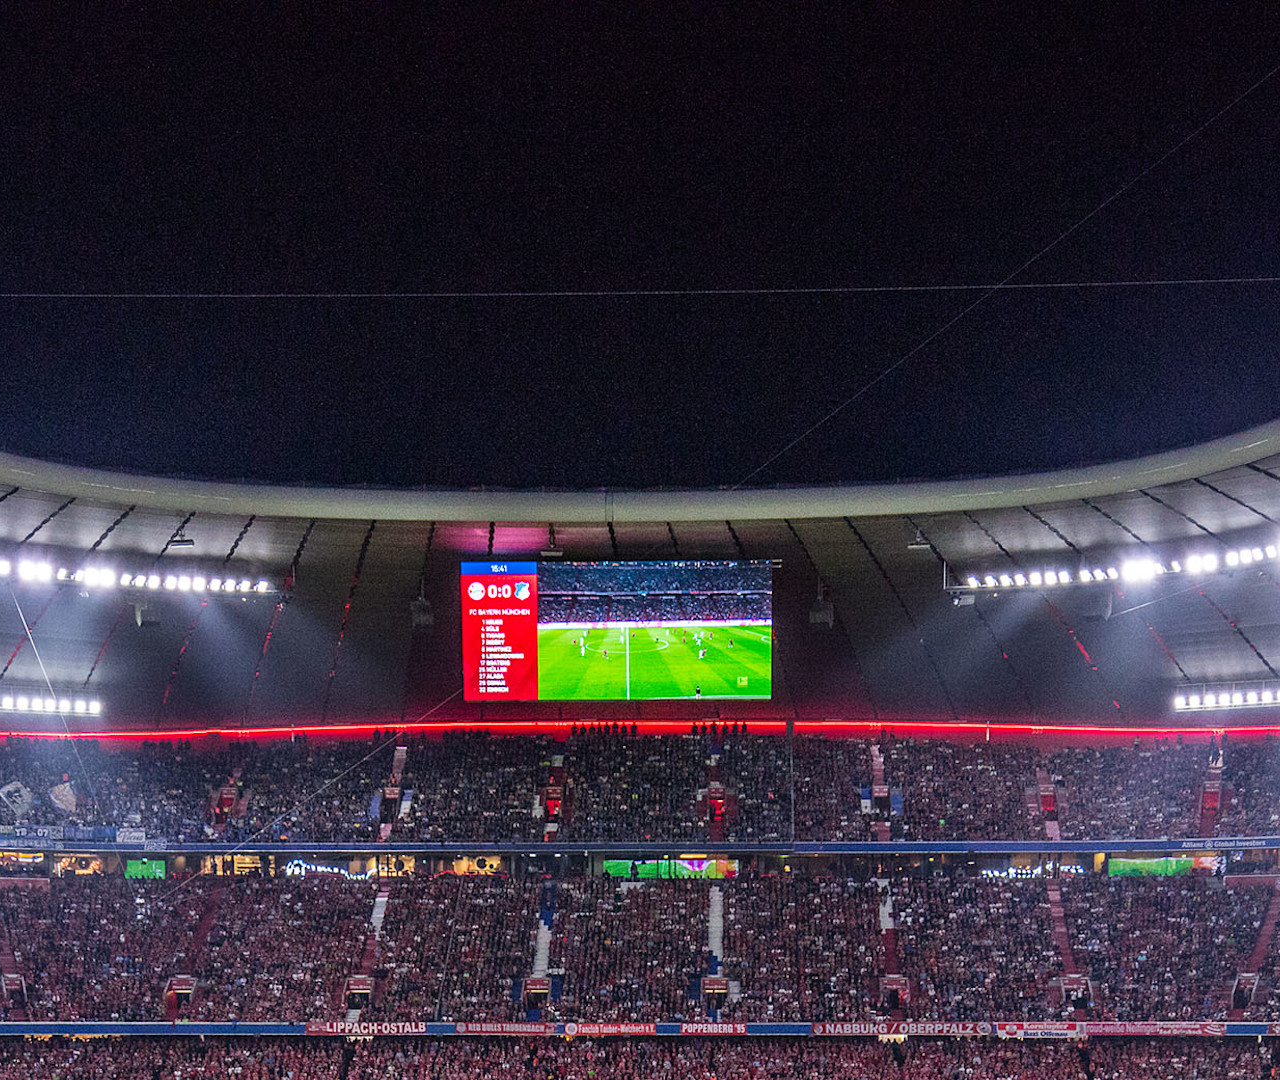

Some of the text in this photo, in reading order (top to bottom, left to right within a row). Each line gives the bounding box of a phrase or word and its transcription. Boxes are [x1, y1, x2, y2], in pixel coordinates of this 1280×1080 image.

[488, 584, 511, 598] 0:0
[1181, 840, 1204, 848] Allianz
[1234, 839, 1266, 847] Investors
[326, 1022, 426, 1033] LIPPACH-OSTALB
[682, 1023, 733, 1033] POPPENBERG
[826, 1023, 974, 1034] NABBURG OBERPFALZ
